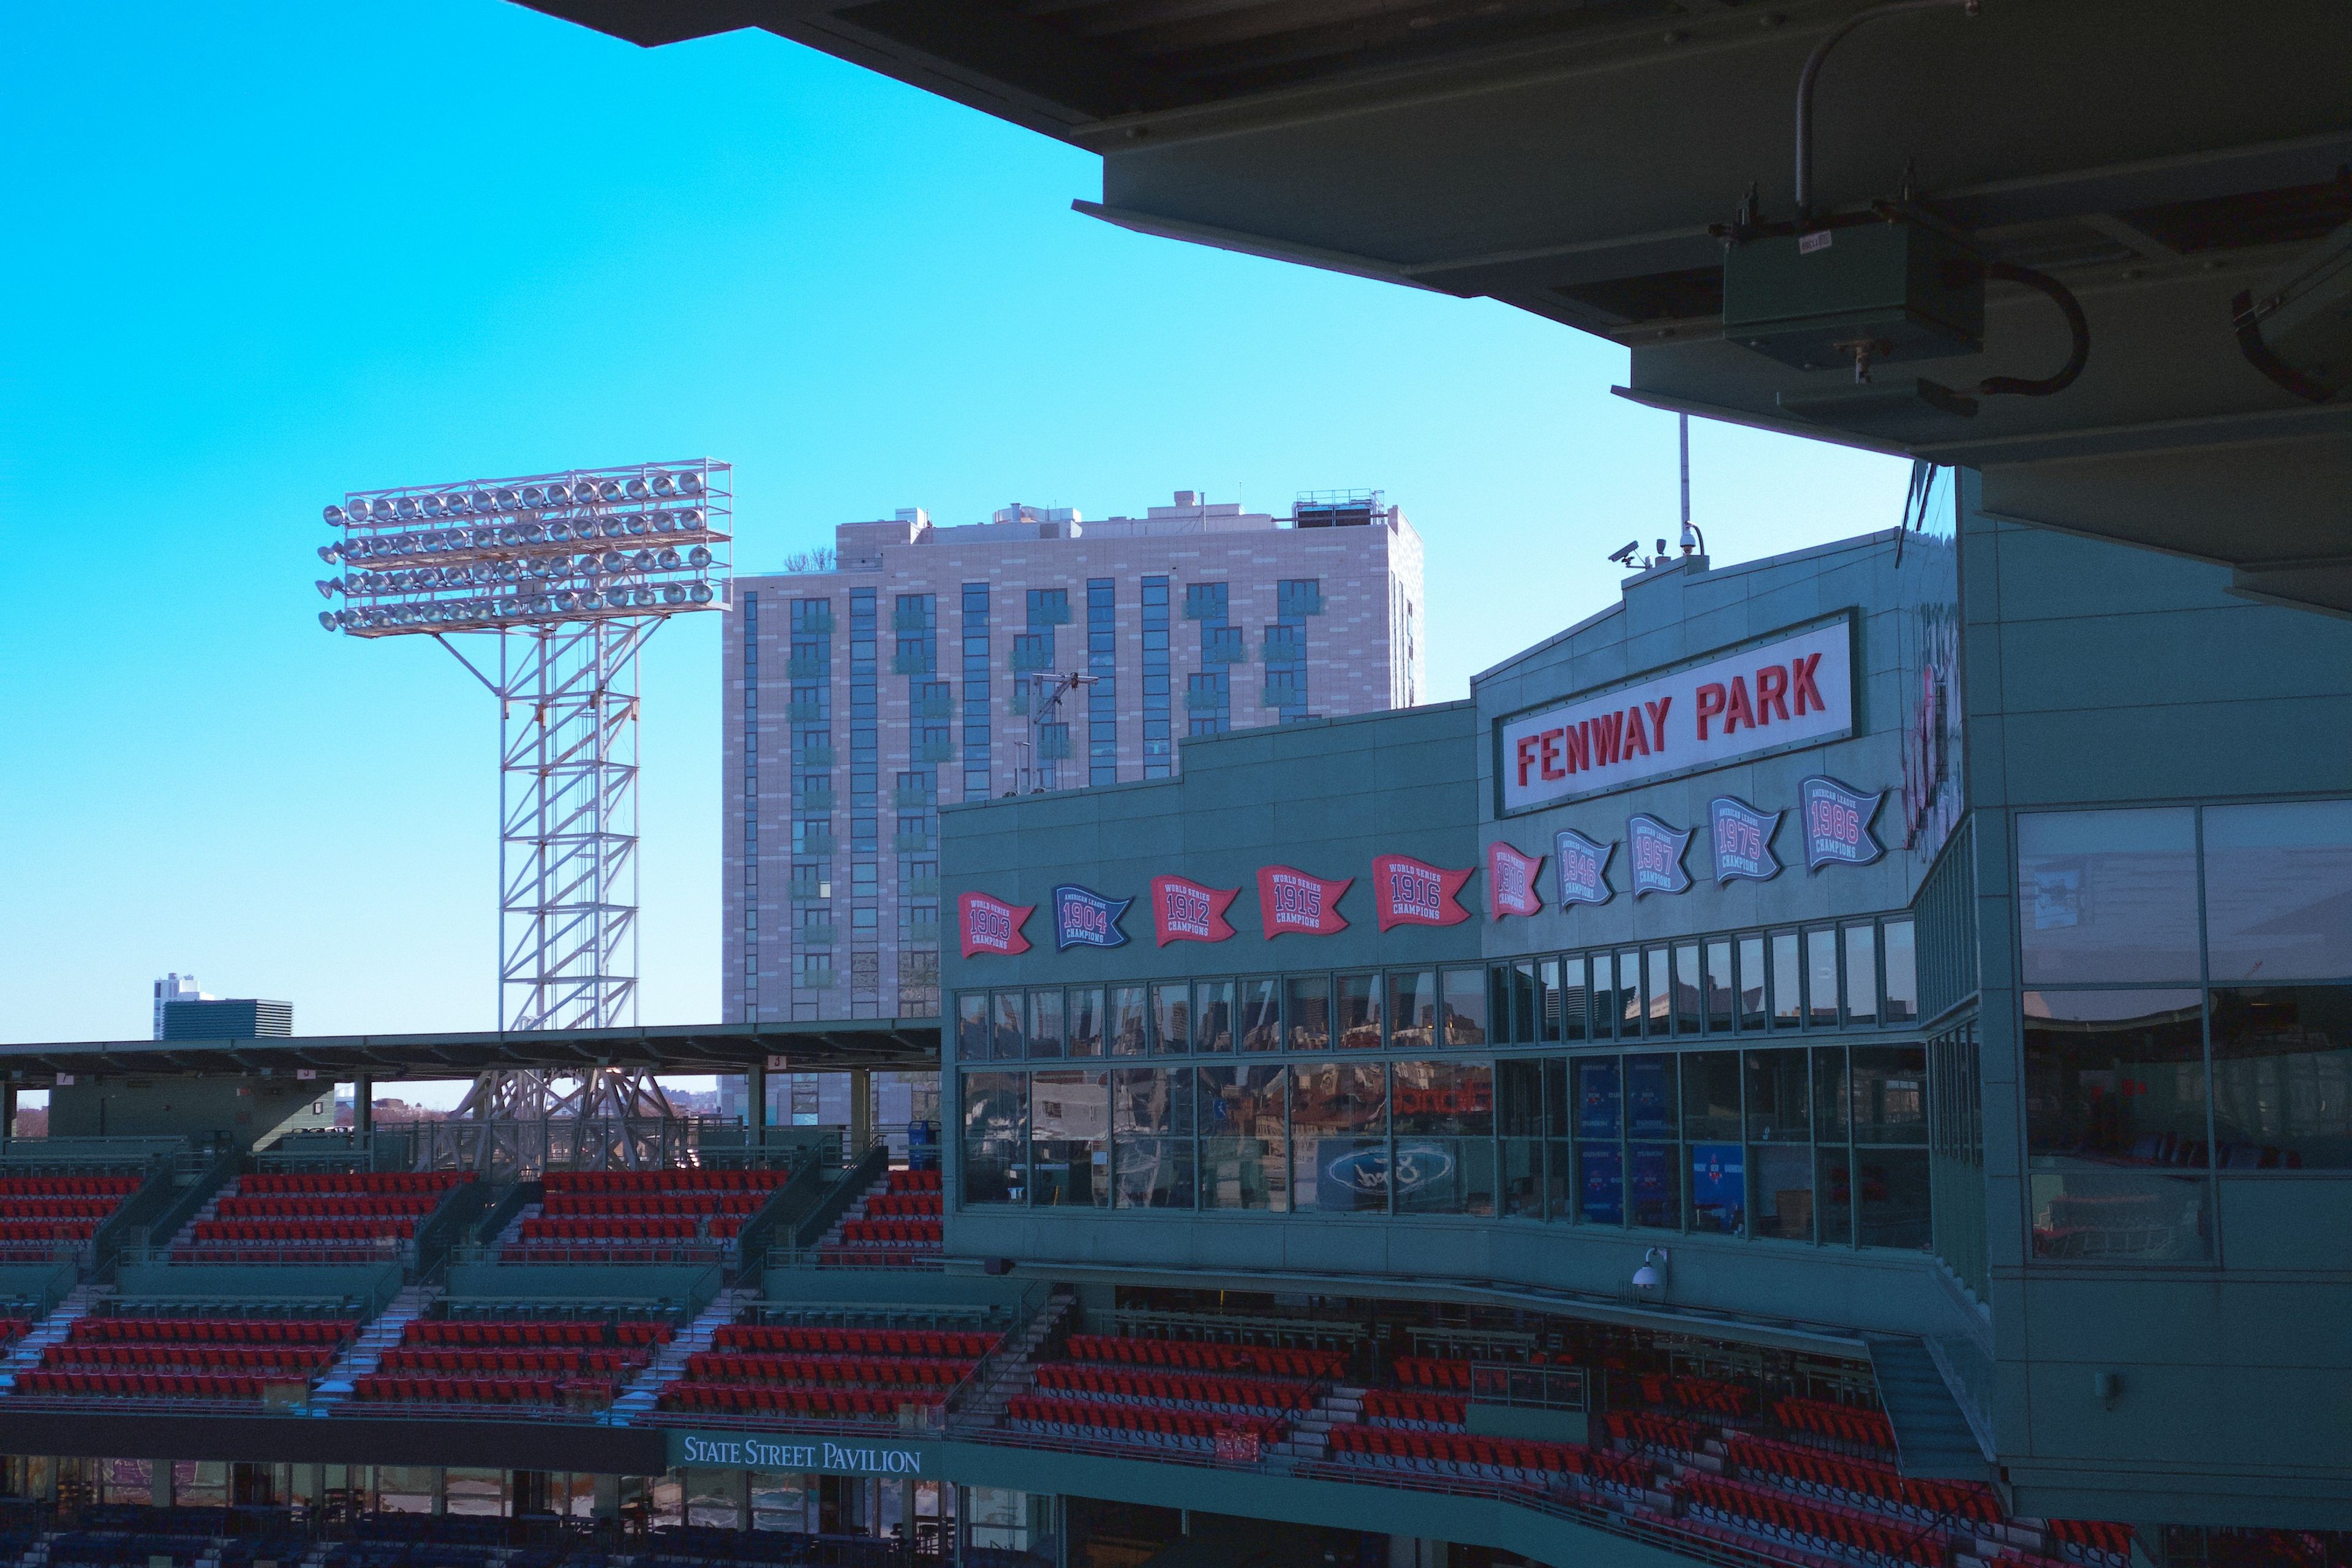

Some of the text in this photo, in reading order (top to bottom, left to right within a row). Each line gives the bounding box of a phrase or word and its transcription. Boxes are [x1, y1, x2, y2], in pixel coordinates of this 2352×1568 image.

[1517, 653, 1826, 786] FENWAY PARK
[1812, 789, 1856, 809] AMERICAN LEAGUE
[1720, 808, 1758, 827] AMERICAN LEAGUE
[1812, 801, 1858, 844] 1986
[1637, 826, 1671, 844] AMERICAN LEAGUE
[1719, 819, 1760, 859] 1975
[1563, 840, 1594, 858] AMERICAN LEAGUE
[1637, 837, 1673, 875] 1967
[1816, 840, 1856, 858] CHAMPIONS
[1496, 853, 1525, 870] WORLD SERIES
[1562, 850, 1596, 887] 1946
[1722, 856, 1758, 873] CHAMPIONS
[1389, 864, 1441, 882] WORLD SERIES
[1498, 862, 1525, 898] 1918
[1640, 870, 1671, 888] CHAMPIONS
[1273, 875, 1321, 892] WORLD SERIES
[1392, 875, 1440, 908] 1916
[1566, 883, 1594, 899] CHAMPIONS
[1065, 894, 1106, 910] AMERICAN LEAGUE
[1165, 884, 1210, 902] WORLD SERIES
[1275, 884, 1321, 918] 1915
[1499, 894, 1525, 910] CHAMPIONS
[971, 900, 1009, 917] WORLD SERIES
[1167, 894, 1209, 926] 1912
[1393, 903, 1439, 919] CHAMPIONS
[970, 910, 1010, 940] 1903
[1063, 902, 1107, 934] 1904
[1276, 913, 1319, 928] CHAMPIONS
[1066, 929, 1103, 943] CHAMPIONS
[1169, 921, 1208, 936] CHAMPIONS
[973, 935, 1007, 949] CHAMPIONS
[685, 1436, 921, 1474] STATE STREET PAVILION
